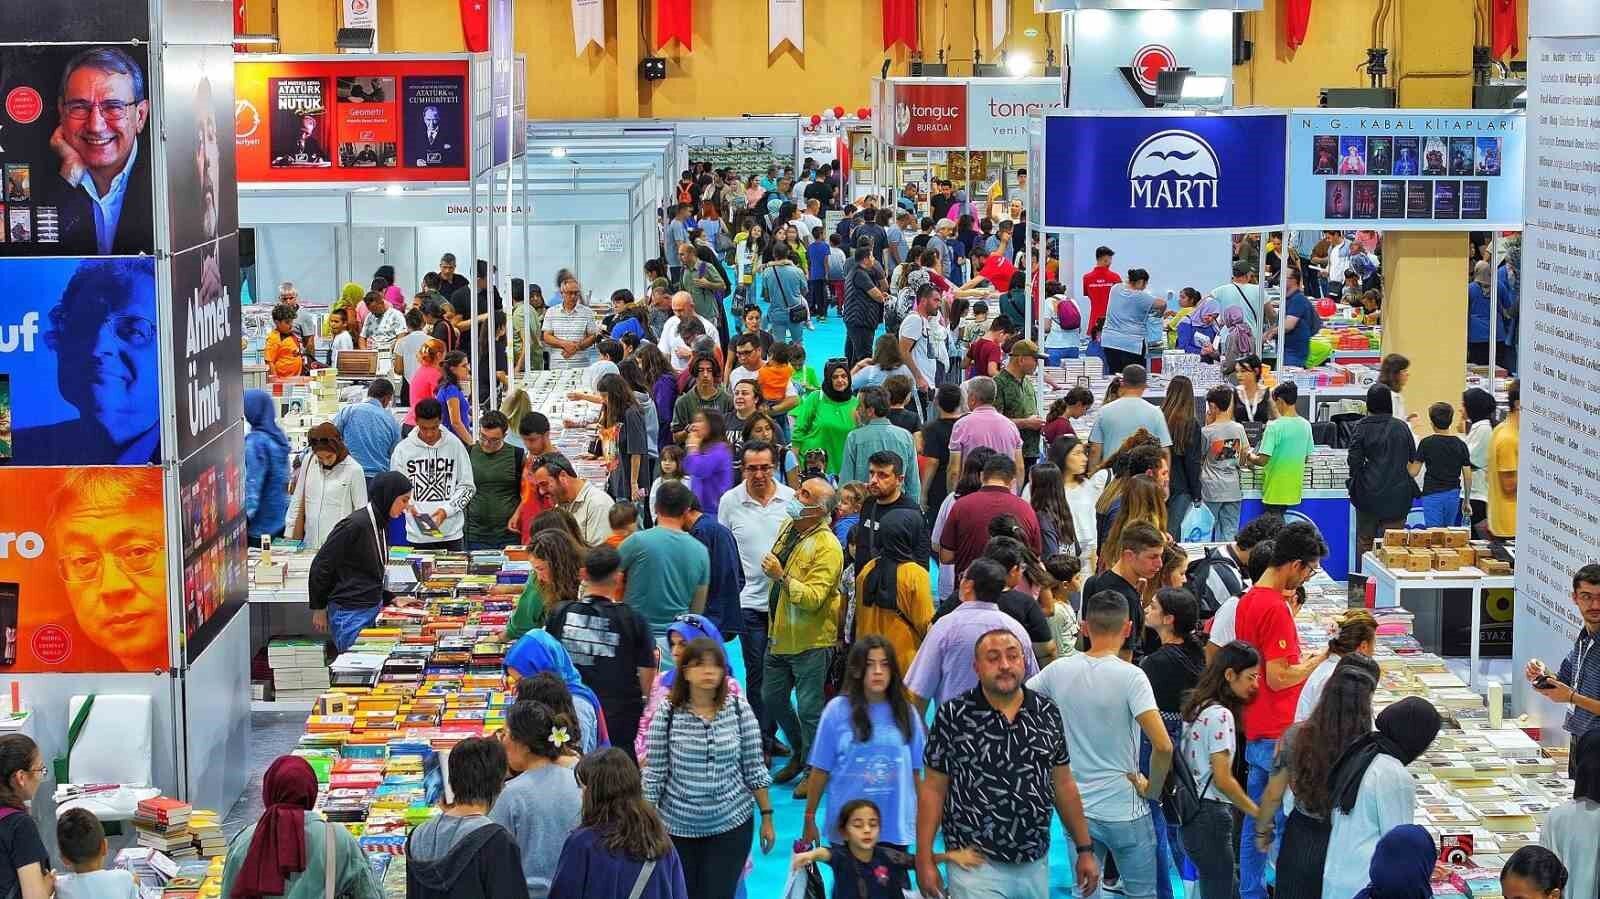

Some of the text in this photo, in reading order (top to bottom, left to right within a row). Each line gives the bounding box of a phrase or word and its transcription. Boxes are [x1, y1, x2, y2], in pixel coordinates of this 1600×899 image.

[278, 97, 321, 110] NUTUK
[911, 102, 960, 121] tonguç
[916, 123, 952, 133] BURADA!
[1359, 119, 1415, 130] KABAL
[1424, 117, 1515, 131] KİTAPLARI
[992, 126, 1017, 137] Yeni
[1129, 179, 1219, 209] MARTI
[185, 285, 232, 359] Ahmet
[187, 360, 222, 437] Ümit
[1479, 631, 1507, 641] EYAZ
